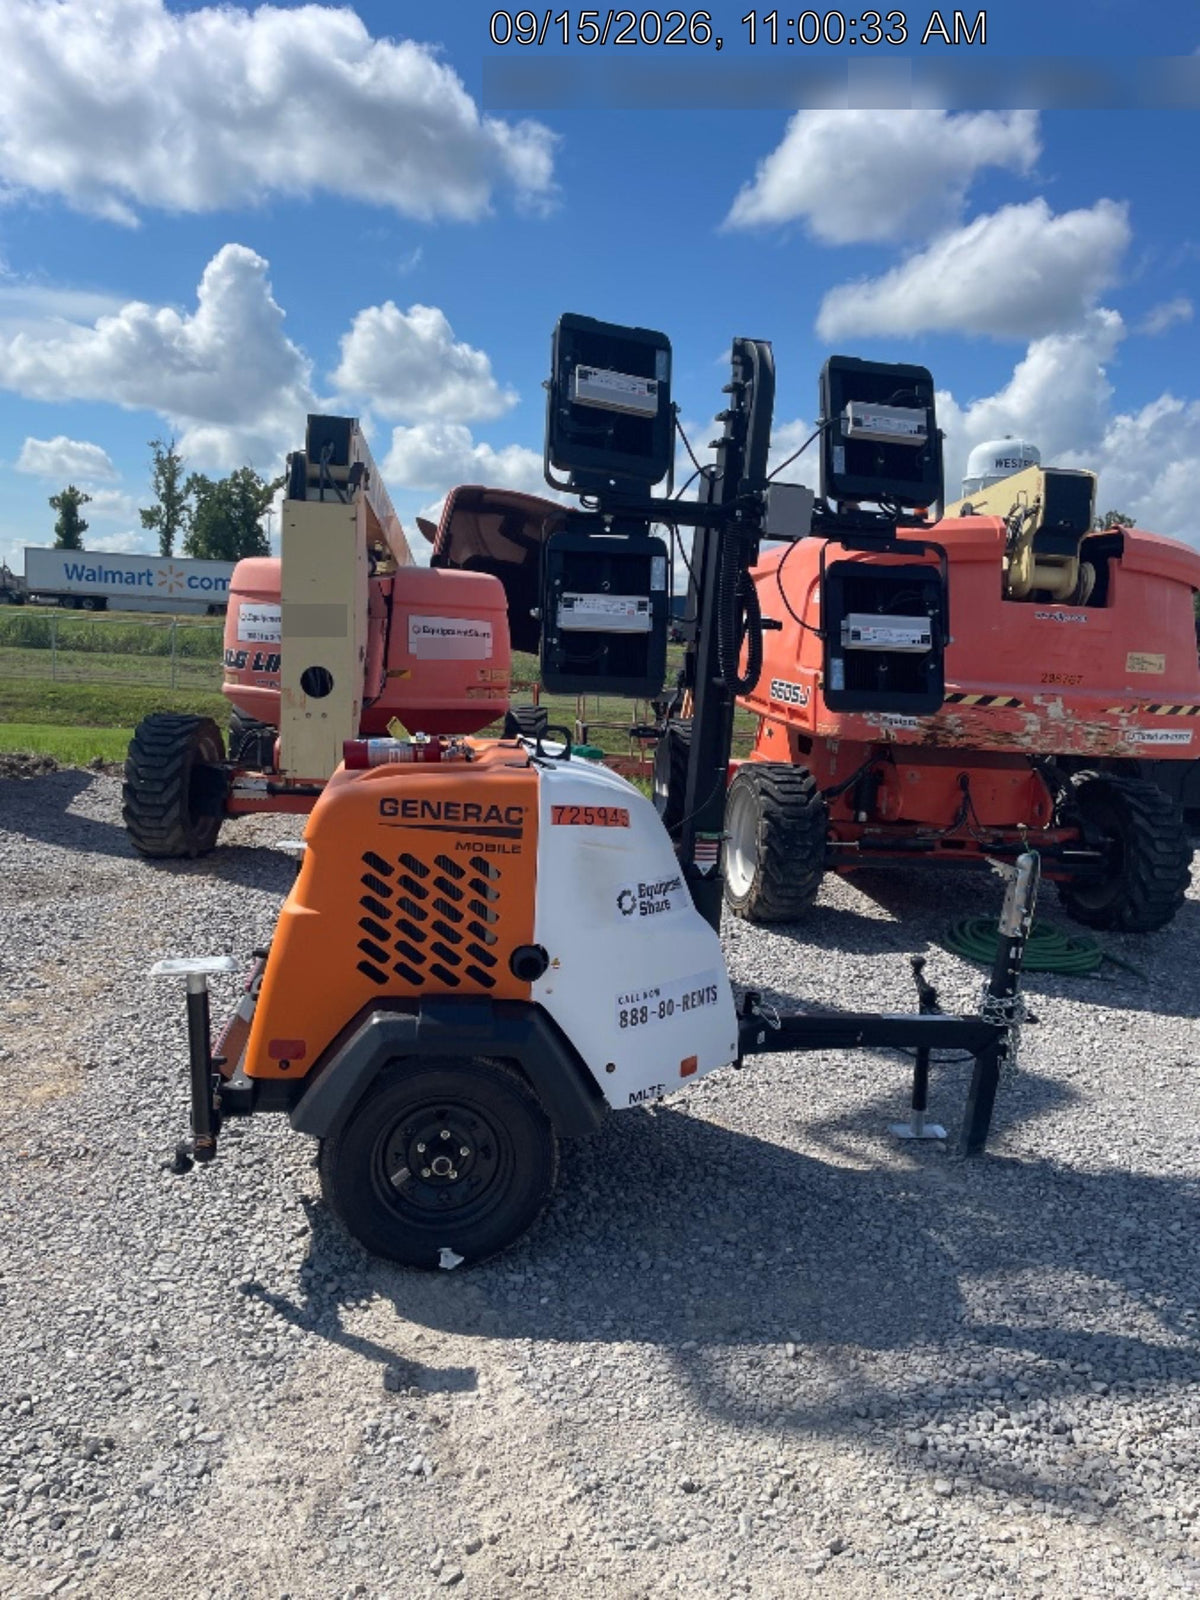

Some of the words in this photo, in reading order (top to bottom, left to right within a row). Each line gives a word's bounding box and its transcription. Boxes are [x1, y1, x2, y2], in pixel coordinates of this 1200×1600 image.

[64, 563, 153, 587] Walmart
[379, 798, 523, 825] GENERAC
[455, 840, 521, 854] MOBILE
[639, 899, 671, 916] Share
[618, 993, 640, 1005] CALL
[619, 984, 718, 1029] 888-80-RENTS
